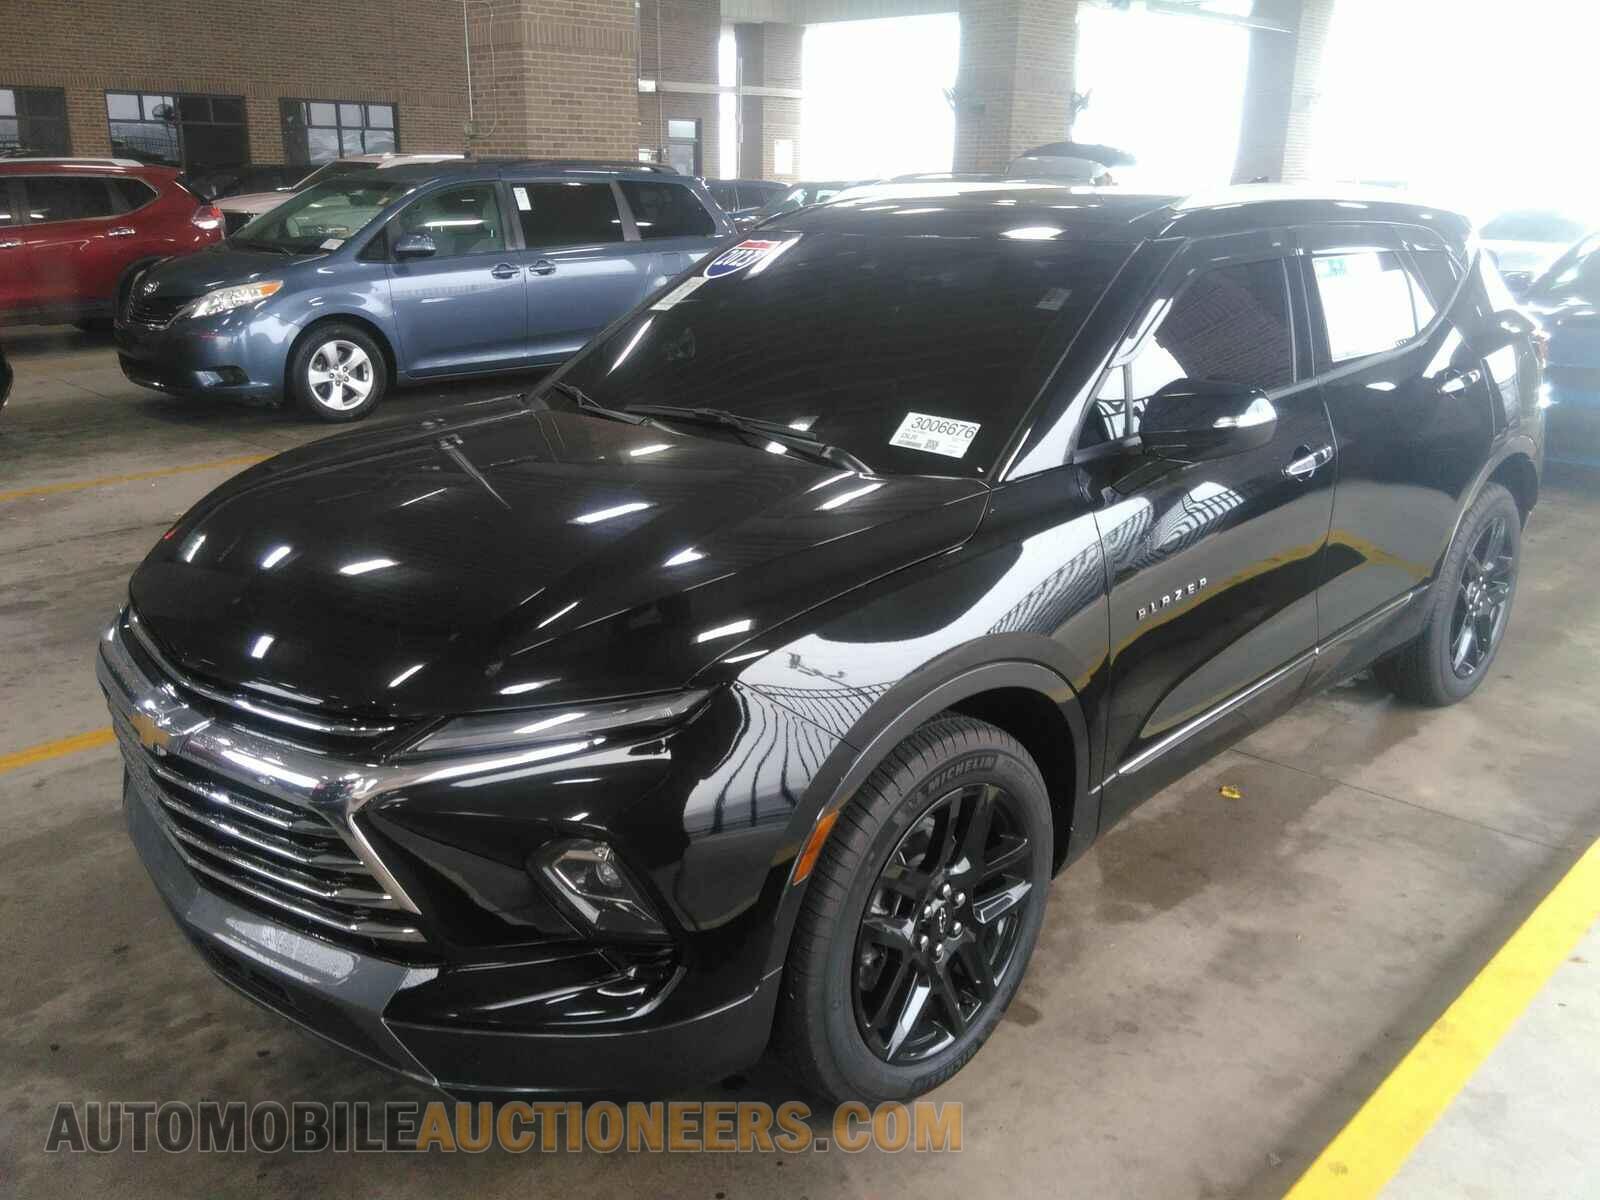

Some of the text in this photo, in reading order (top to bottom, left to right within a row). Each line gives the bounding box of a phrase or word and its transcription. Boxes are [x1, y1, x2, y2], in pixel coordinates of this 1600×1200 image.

[911, 416, 977, 439] 3006676
[1136, 577, 1208, 621] BLAZER
[928, 757, 995, 792] MICHELIN
